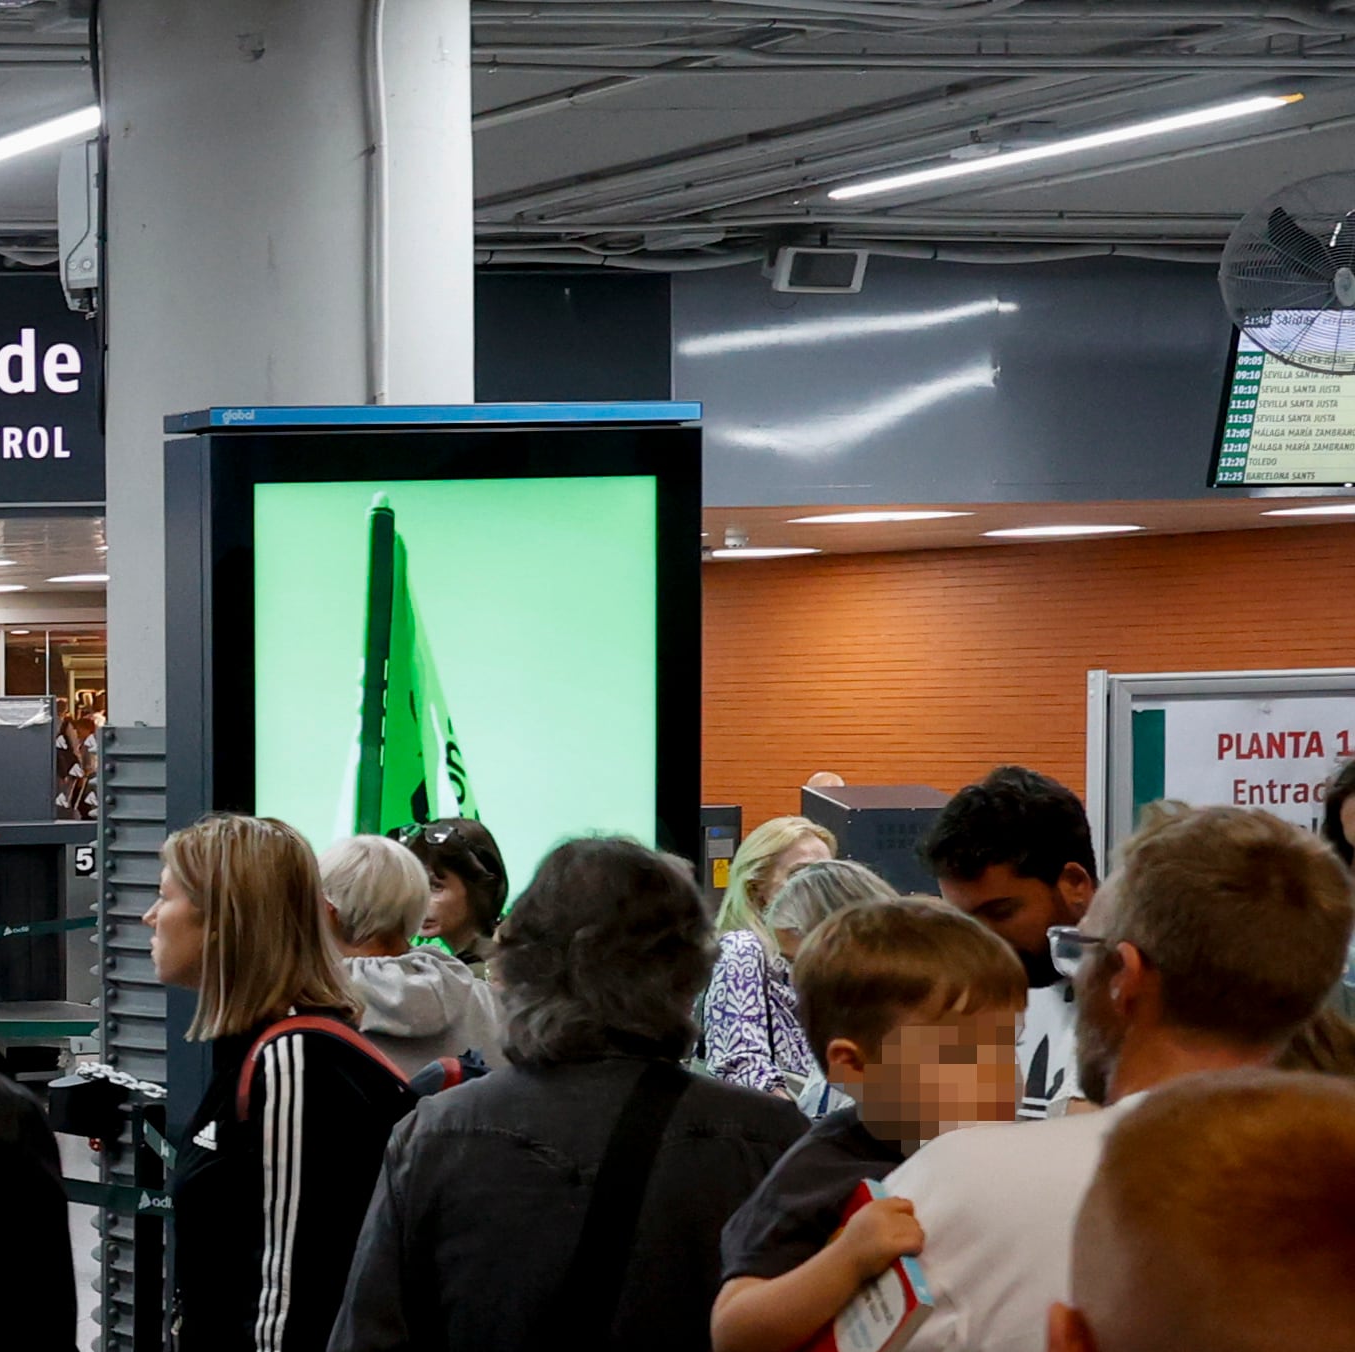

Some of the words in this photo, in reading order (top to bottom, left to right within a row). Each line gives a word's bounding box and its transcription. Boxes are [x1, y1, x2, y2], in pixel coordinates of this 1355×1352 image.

[1238, 356, 1264, 365] 09:05
[1235, 371, 1260, 380] 09:10
[1264, 371, 1292, 380] SEVILLA
[1295, 371, 1320, 379] SANTA
[1232, 385, 1258, 394] 10:10
[1261, 385, 1290, 394] SEVILLA
[1293, 385, 1317, 393] SANTA
[1319, 385, 1341, 393] JUSTA
[1230, 400, 1255, 409] 11:10
[1258, 400, 1288, 408] SEVILLA
[1290, 400, 1314, 408] SANTA
[1316, 400, 1338, 408] JUSTA
[222, 409, 255, 424] global
[1228, 414, 1253, 423] 11:53
[1256, 414, 1285, 422] SEVILLA
[1288, 414, 1312, 422] SANTA
[1314, 414, 1336, 422] JUSTA
[1225, 428, 1250, 437] 12:05
[1254, 428, 1285, 437] MÁLAGA
[1251, 442, 1282, 451] MÁLAGA
[1221, 457, 1245, 466] 12:20
[1249, 457, 1277, 466] TOLEDO
[1218, 472, 1243, 481] 12:25
[1246, 472, 1289, 480] BARCELONA
[1292, 472, 1315, 480] SANTS
[1218, 731, 1325, 760] PLANTA
[1336, 730, 1355, 757] 1
[75, 848, 93, 871] 5
[152, 1195, 173, 1209] adi
